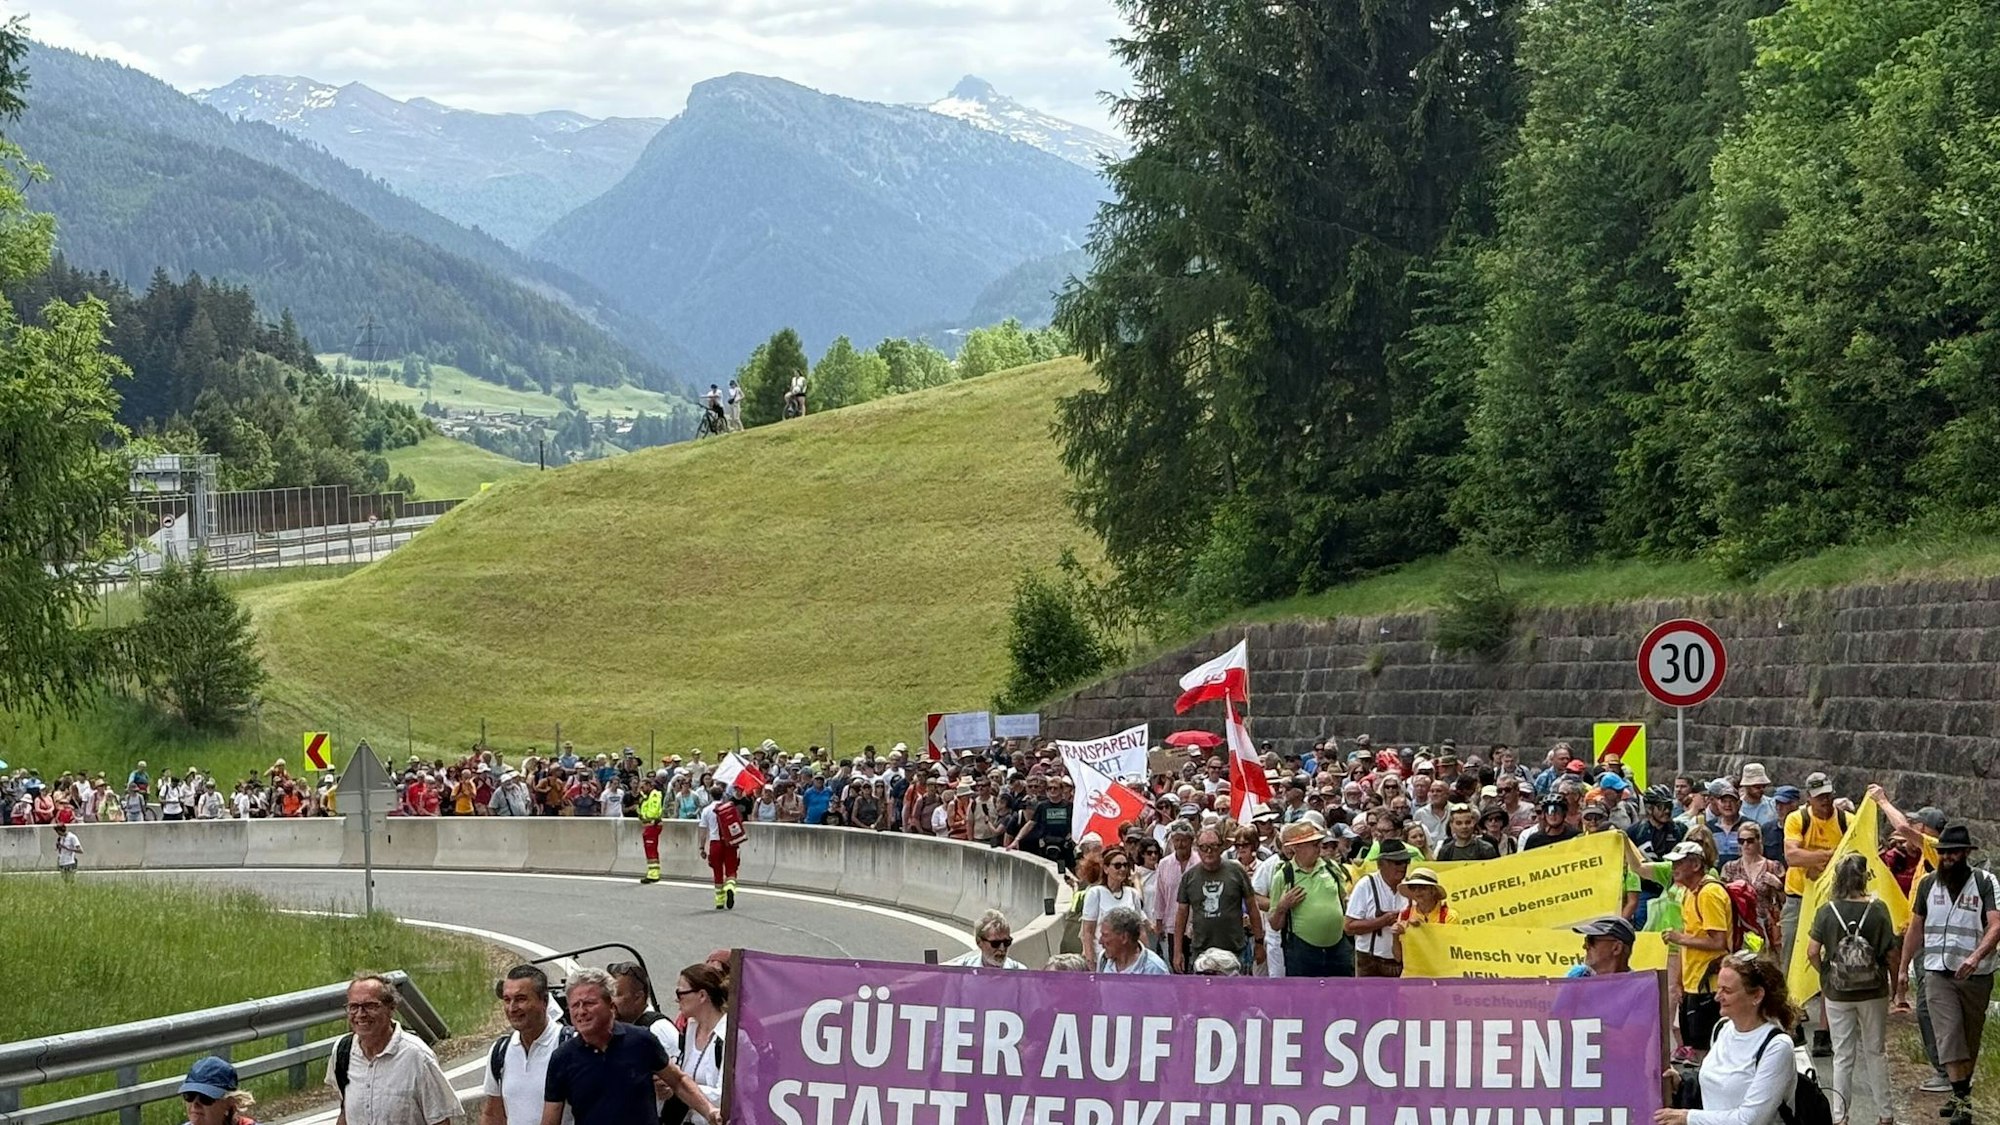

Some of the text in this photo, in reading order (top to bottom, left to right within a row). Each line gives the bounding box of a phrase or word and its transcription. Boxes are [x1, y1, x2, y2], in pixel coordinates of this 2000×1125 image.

[1660, 643, 1705, 683] 30
[1450, 855, 1604, 902] STAUFREI, MAUTFREI
[1499, 887, 1594, 918] Lebensraum
[1449, 946, 1586, 966] Mensch vor Verk
[800, 984, 1603, 1089] GÜTER AUF DIE SCHIENE
